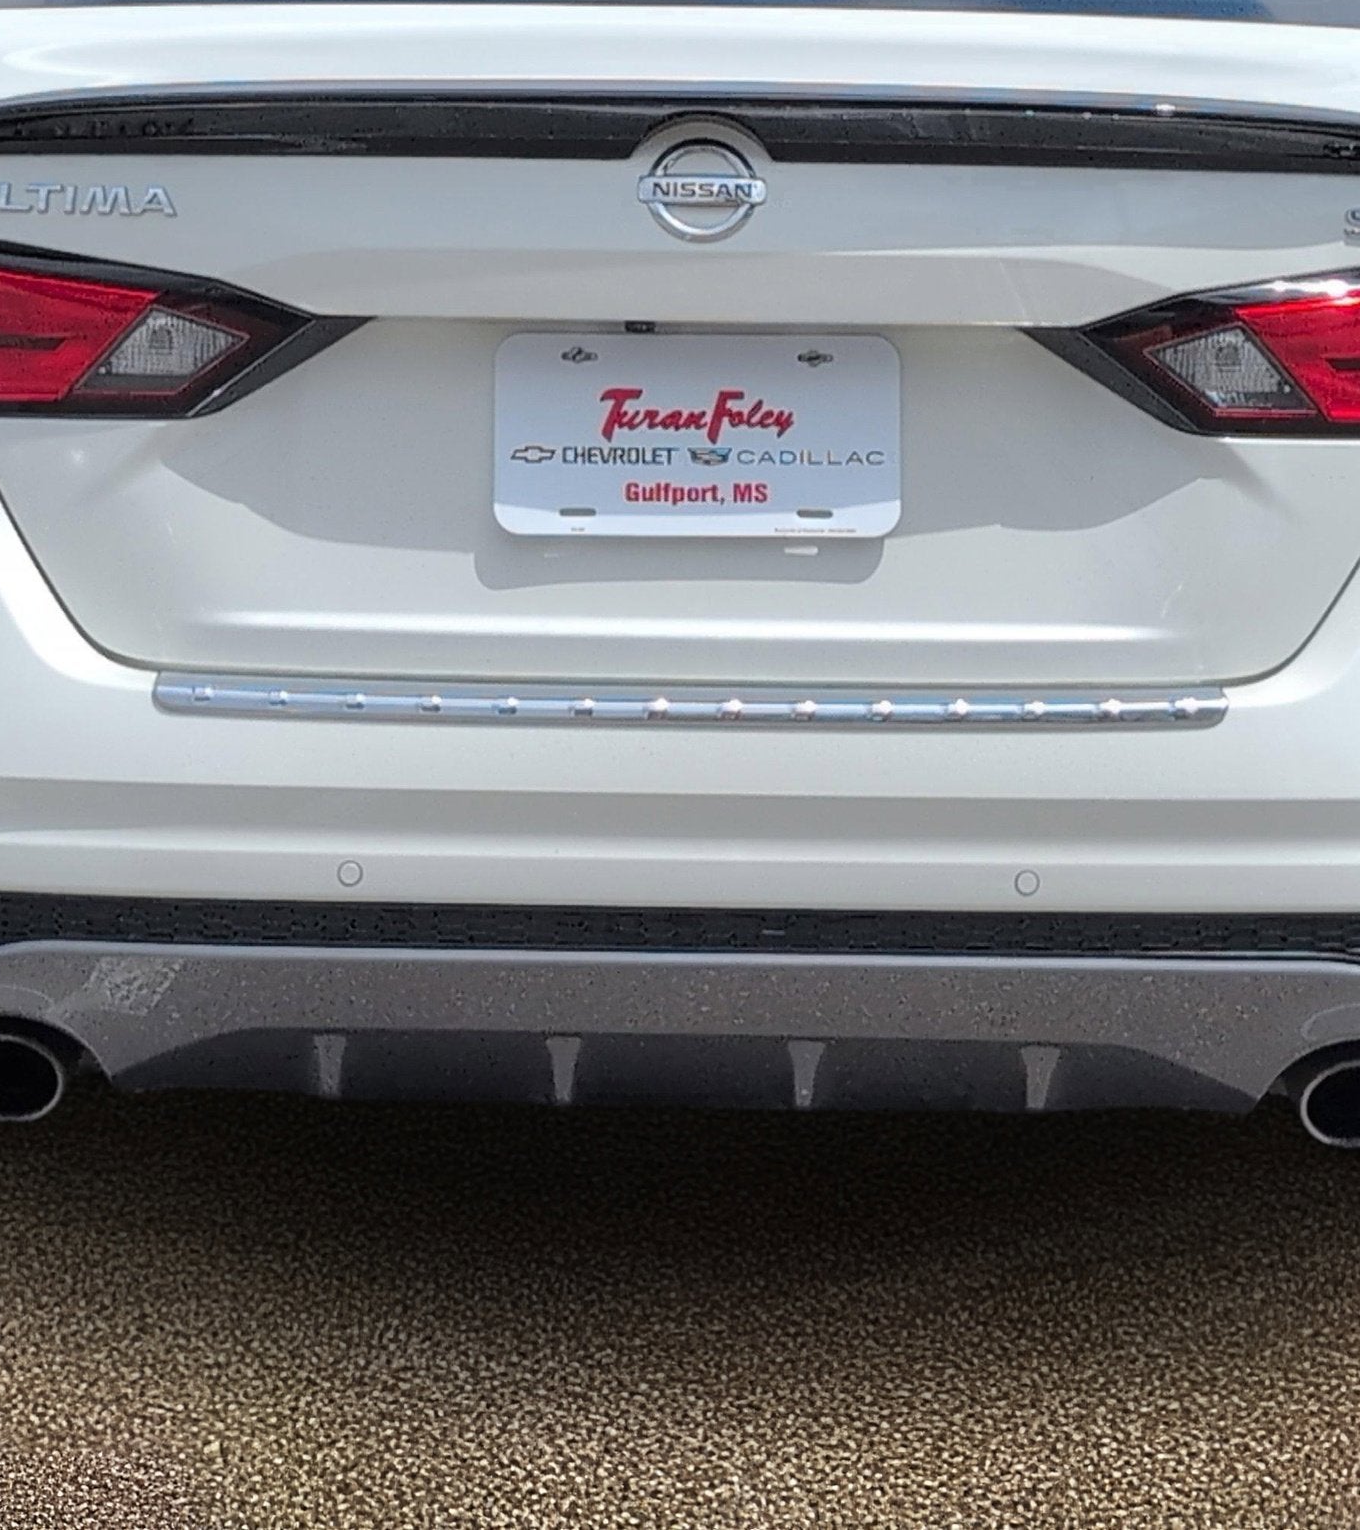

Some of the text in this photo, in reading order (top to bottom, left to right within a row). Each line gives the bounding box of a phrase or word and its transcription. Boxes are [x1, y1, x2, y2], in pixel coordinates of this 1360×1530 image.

[651, 181, 753, 199] NISSAN
[561, 446, 886, 467] CHEVROLET CADILLAC
[624, 482, 769, 505] Gulfport, MS
